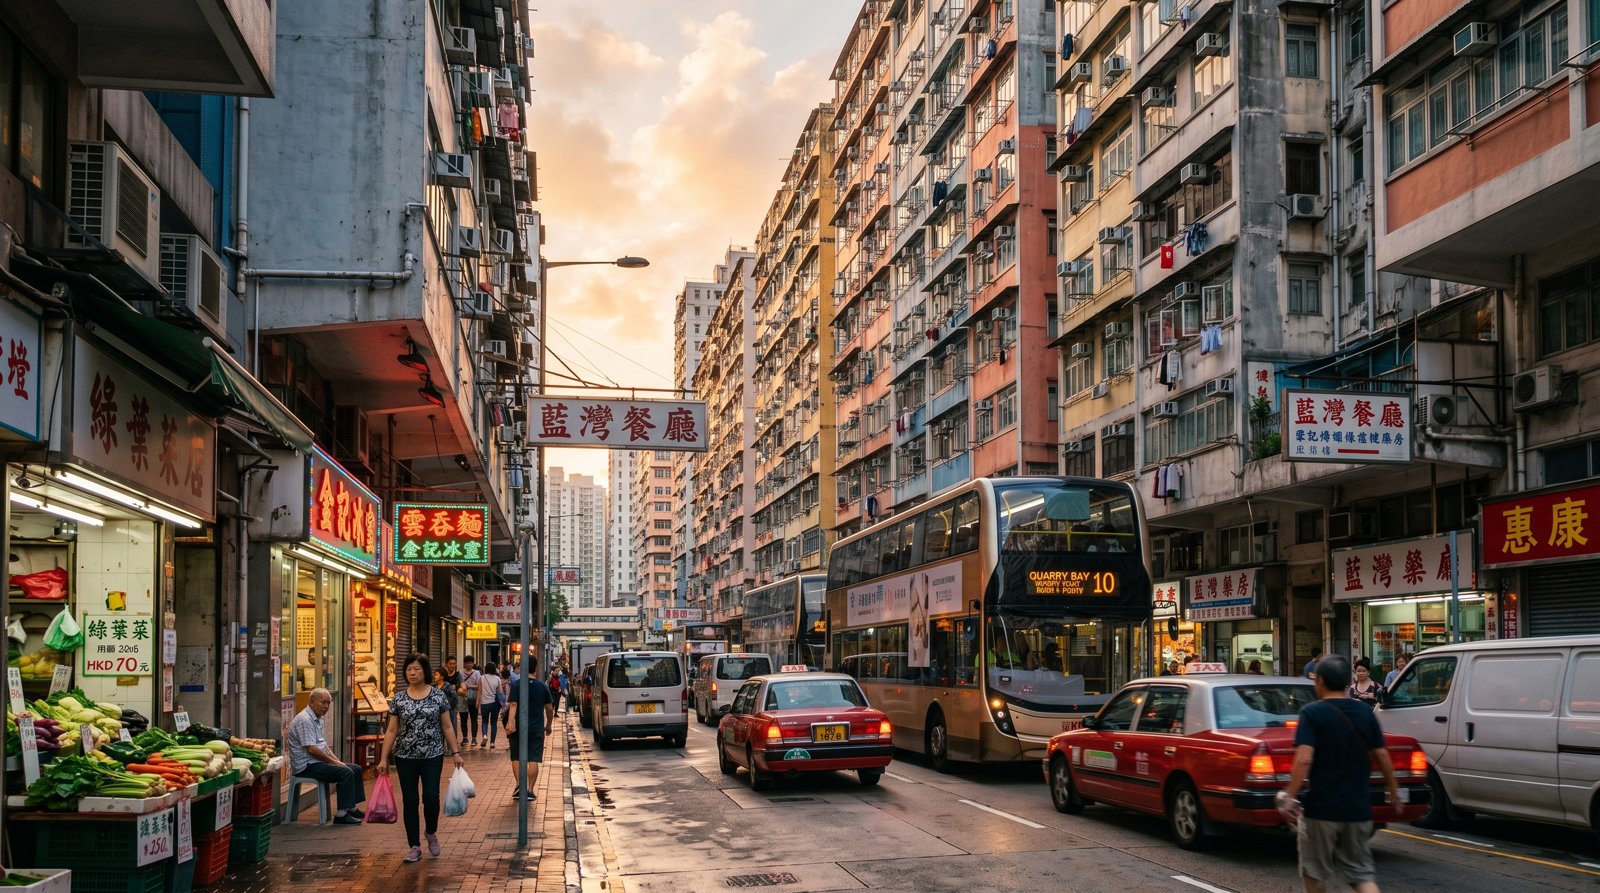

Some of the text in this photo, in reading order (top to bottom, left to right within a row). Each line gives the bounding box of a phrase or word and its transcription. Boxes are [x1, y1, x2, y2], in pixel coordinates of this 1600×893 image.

[538, 403, 699, 443] 藍灣餐廳
[1295, 398, 1405, 428] 藍灣餐廳
[402, 509, 483, 538] 雲吞麵
[1502, 496, 1589, 554] 惠康
[1029, 571, 1090, 581] QUARRY BAY
[1093, 572, 1115, 593] 10
[88, 619, 150, 640] 綠葉菜
[87, 657, 150, 672] HKD 70 元
